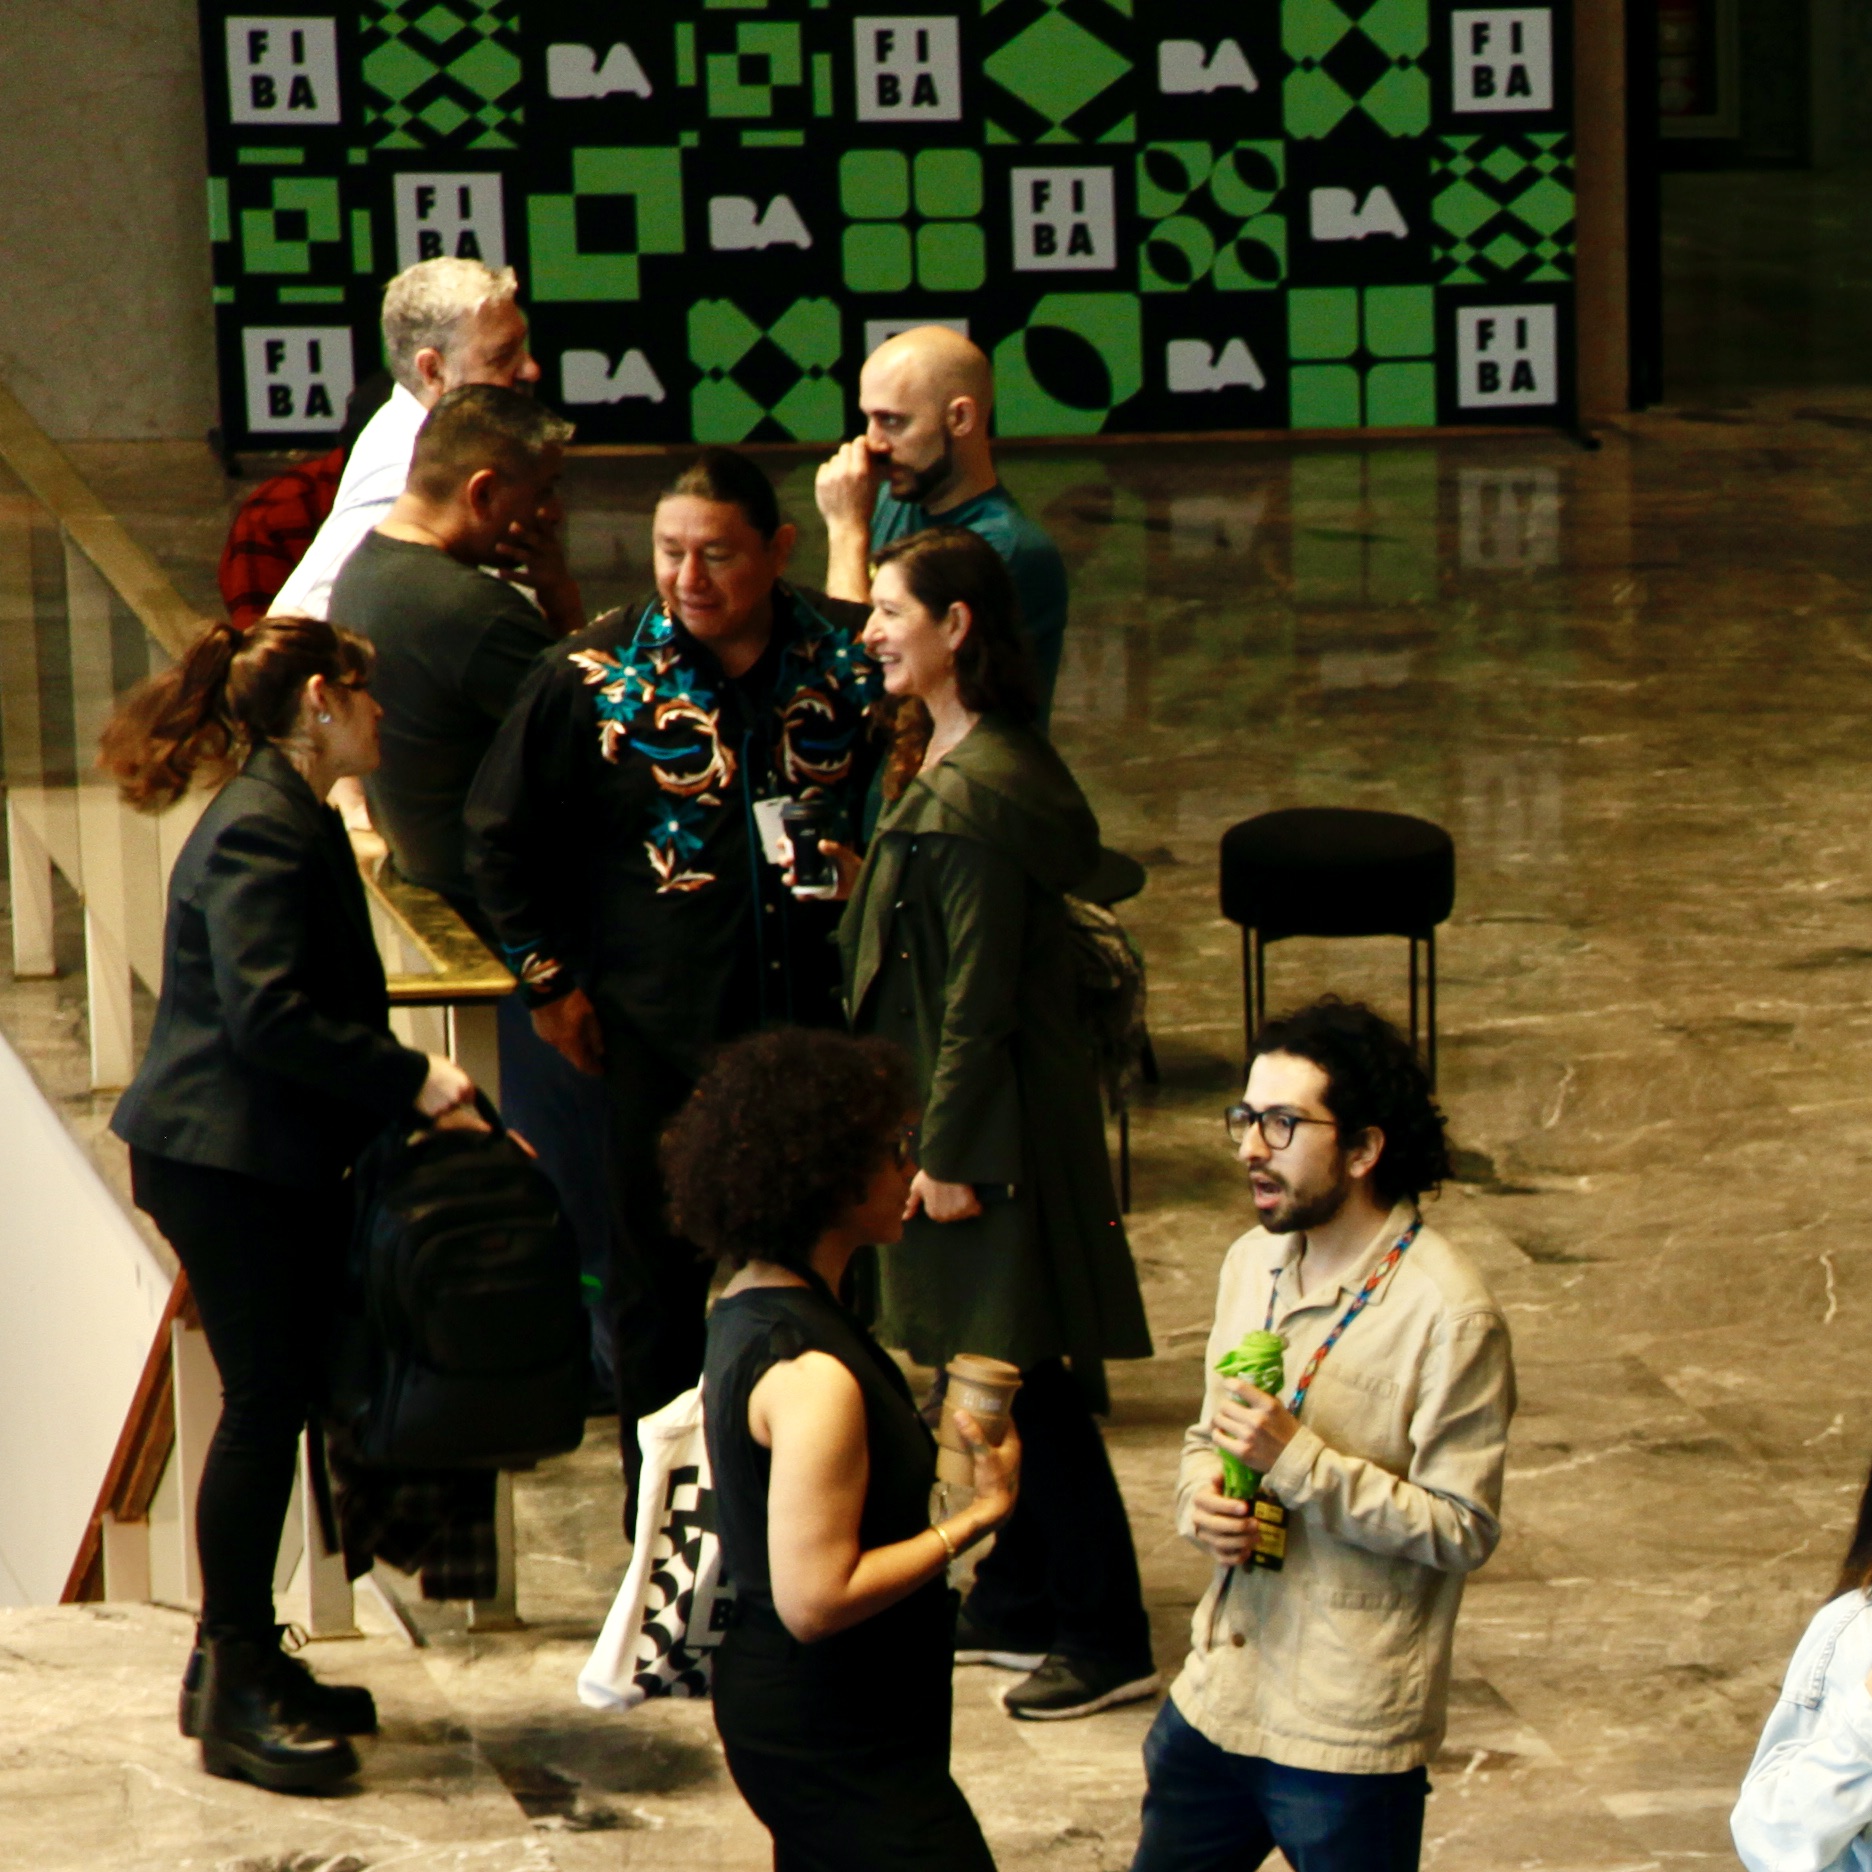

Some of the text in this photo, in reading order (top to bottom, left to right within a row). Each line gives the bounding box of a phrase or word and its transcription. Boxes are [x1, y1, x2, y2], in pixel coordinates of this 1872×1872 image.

[247, 29, 305, 65] FI
[874, 29, 929, 64] FI
[1471, 21, 1523, 56] FI
[249, 73, 317, 110] BA
[876, 72, 939, 108] BA
[1471, 63, 1532, 99] BA
[415, 185, 472, 221] FI
[1031, 179, 1086, 214] FI
[417, 229, 483, 262] BA
[1032, 222, 1095, 257] BA
[1476, 317, 1528, 352] FI
[264, 339, 322, 374] FI
[1477, 359, 1537, 394] BA
[267, 383, 334, 419] BA
